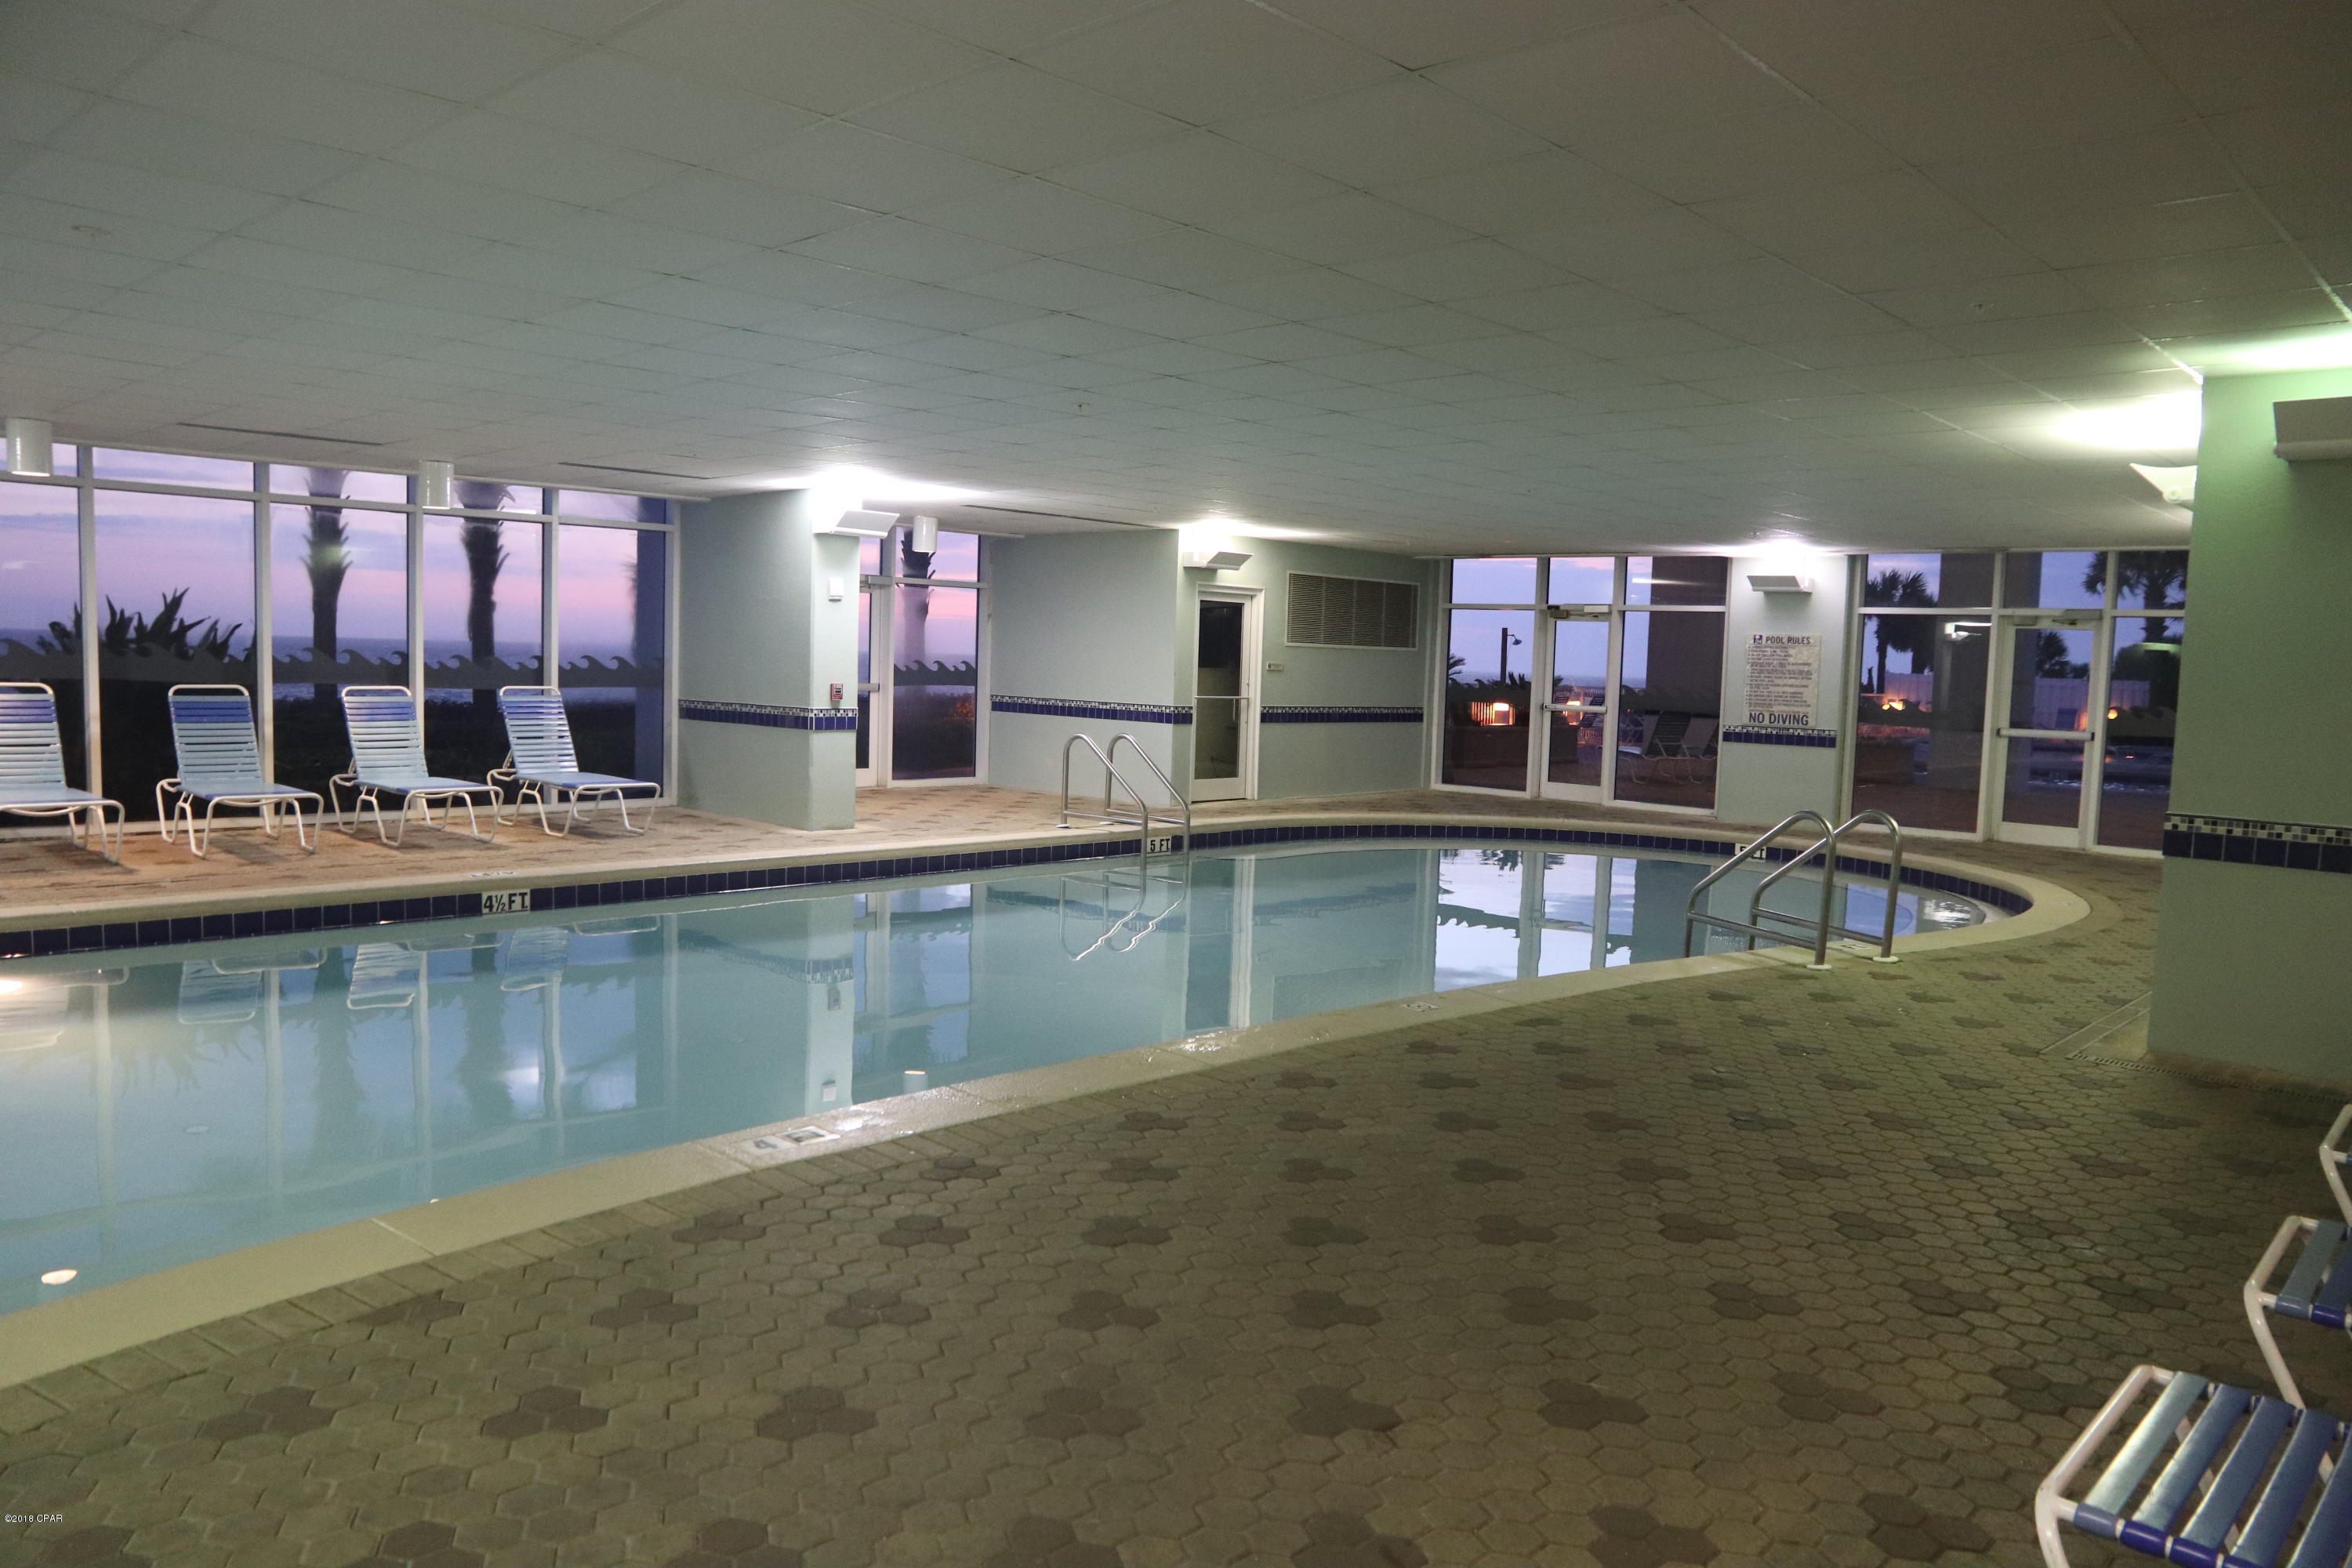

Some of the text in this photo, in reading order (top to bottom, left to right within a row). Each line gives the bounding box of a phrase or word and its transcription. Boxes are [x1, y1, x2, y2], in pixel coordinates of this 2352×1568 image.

[1766, 636, 1811, 644] POOL RULES
[1748, 712, 1809, 726] NO DIVING
[1150, 839, 1156, 852] 5
